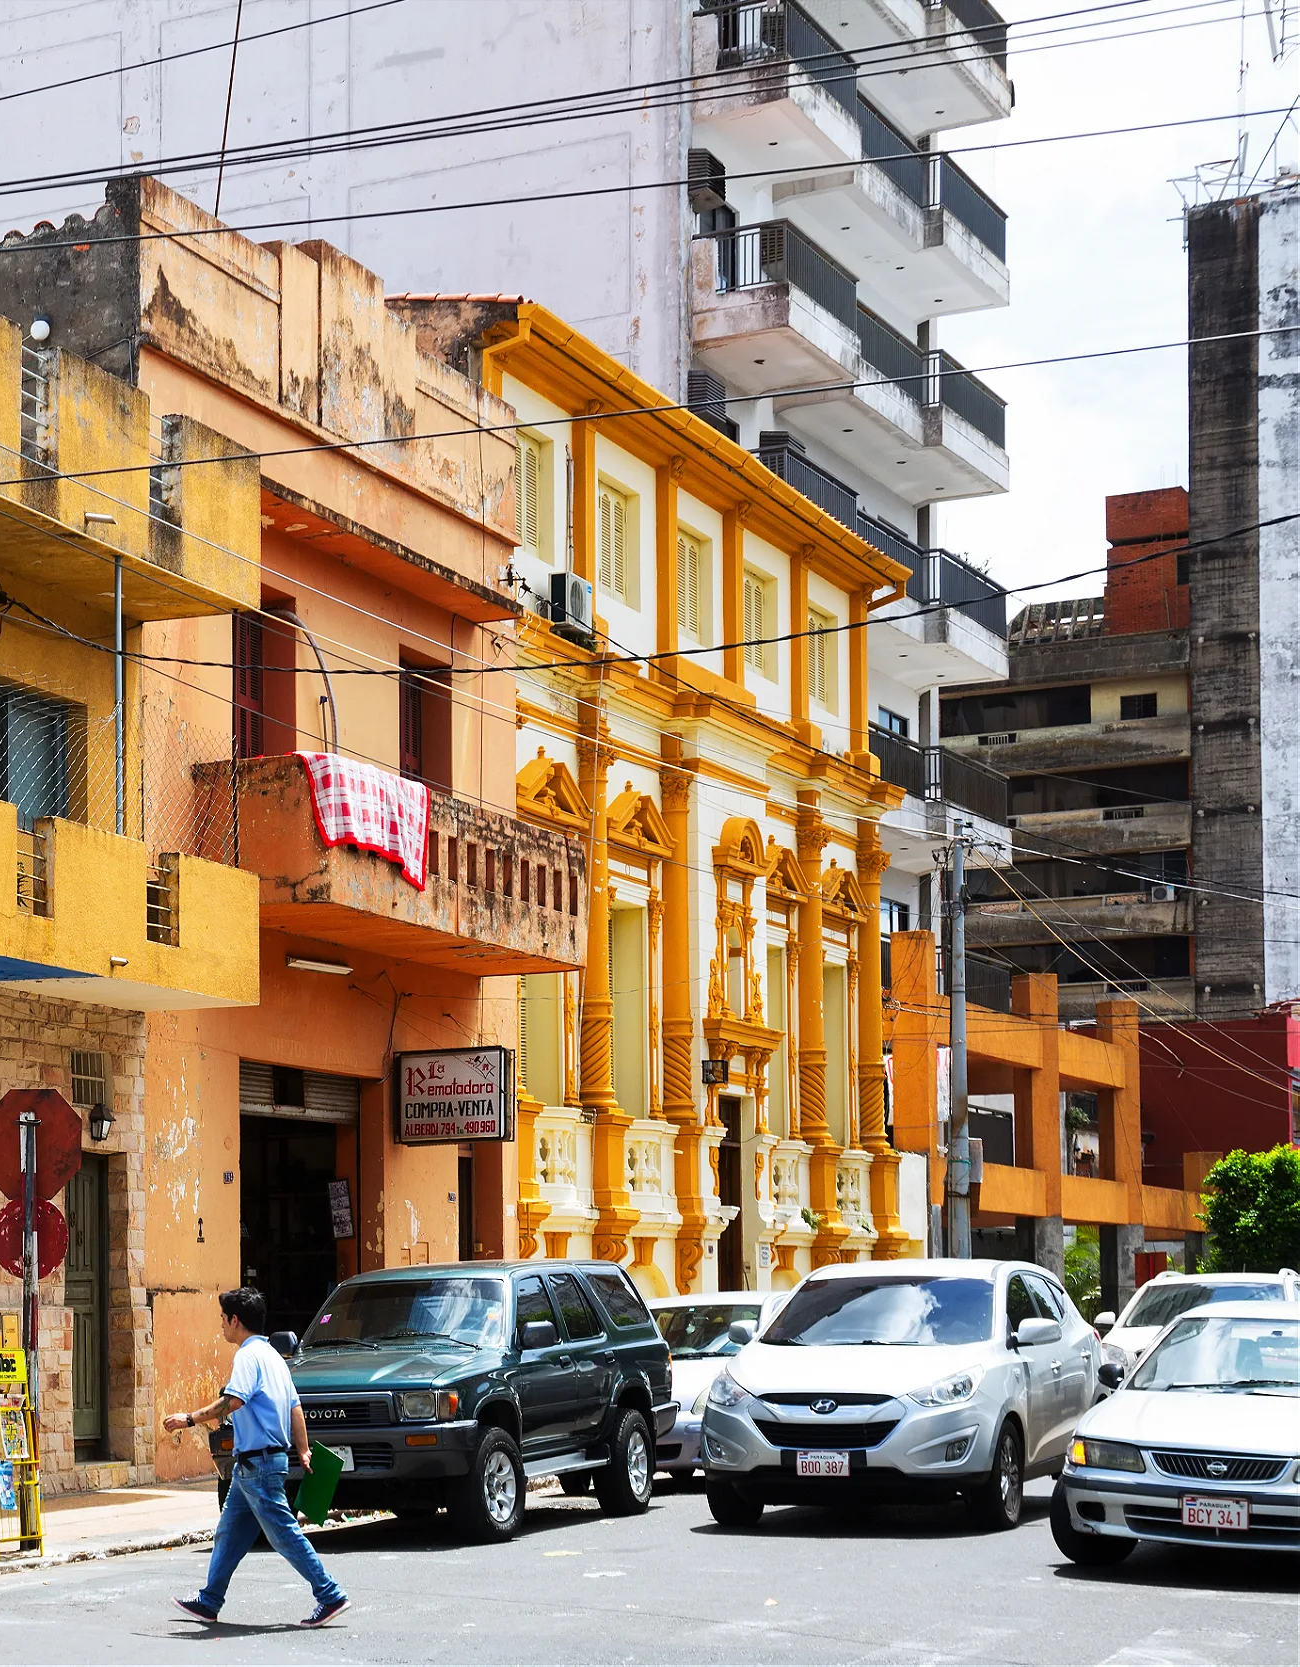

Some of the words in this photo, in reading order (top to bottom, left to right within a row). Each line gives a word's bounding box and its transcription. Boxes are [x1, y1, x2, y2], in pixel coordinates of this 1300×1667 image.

[428, 1060, 445, 1080] La
[405, 1067, 494, 1097] Rematadora
[405, 1099, 494, 1119] COMPRA-VENTA
[404, 1123, 438, 1136] ALBERDI
[440, 1122, 456, 1135] 794
[304, 1409, 346, 1419] TOYOTA
[825, 1460, 844, 1474] 387
[1188, 1507, 1212, 1525] BCY
[1217, 1510, 1241, 1527] 341
